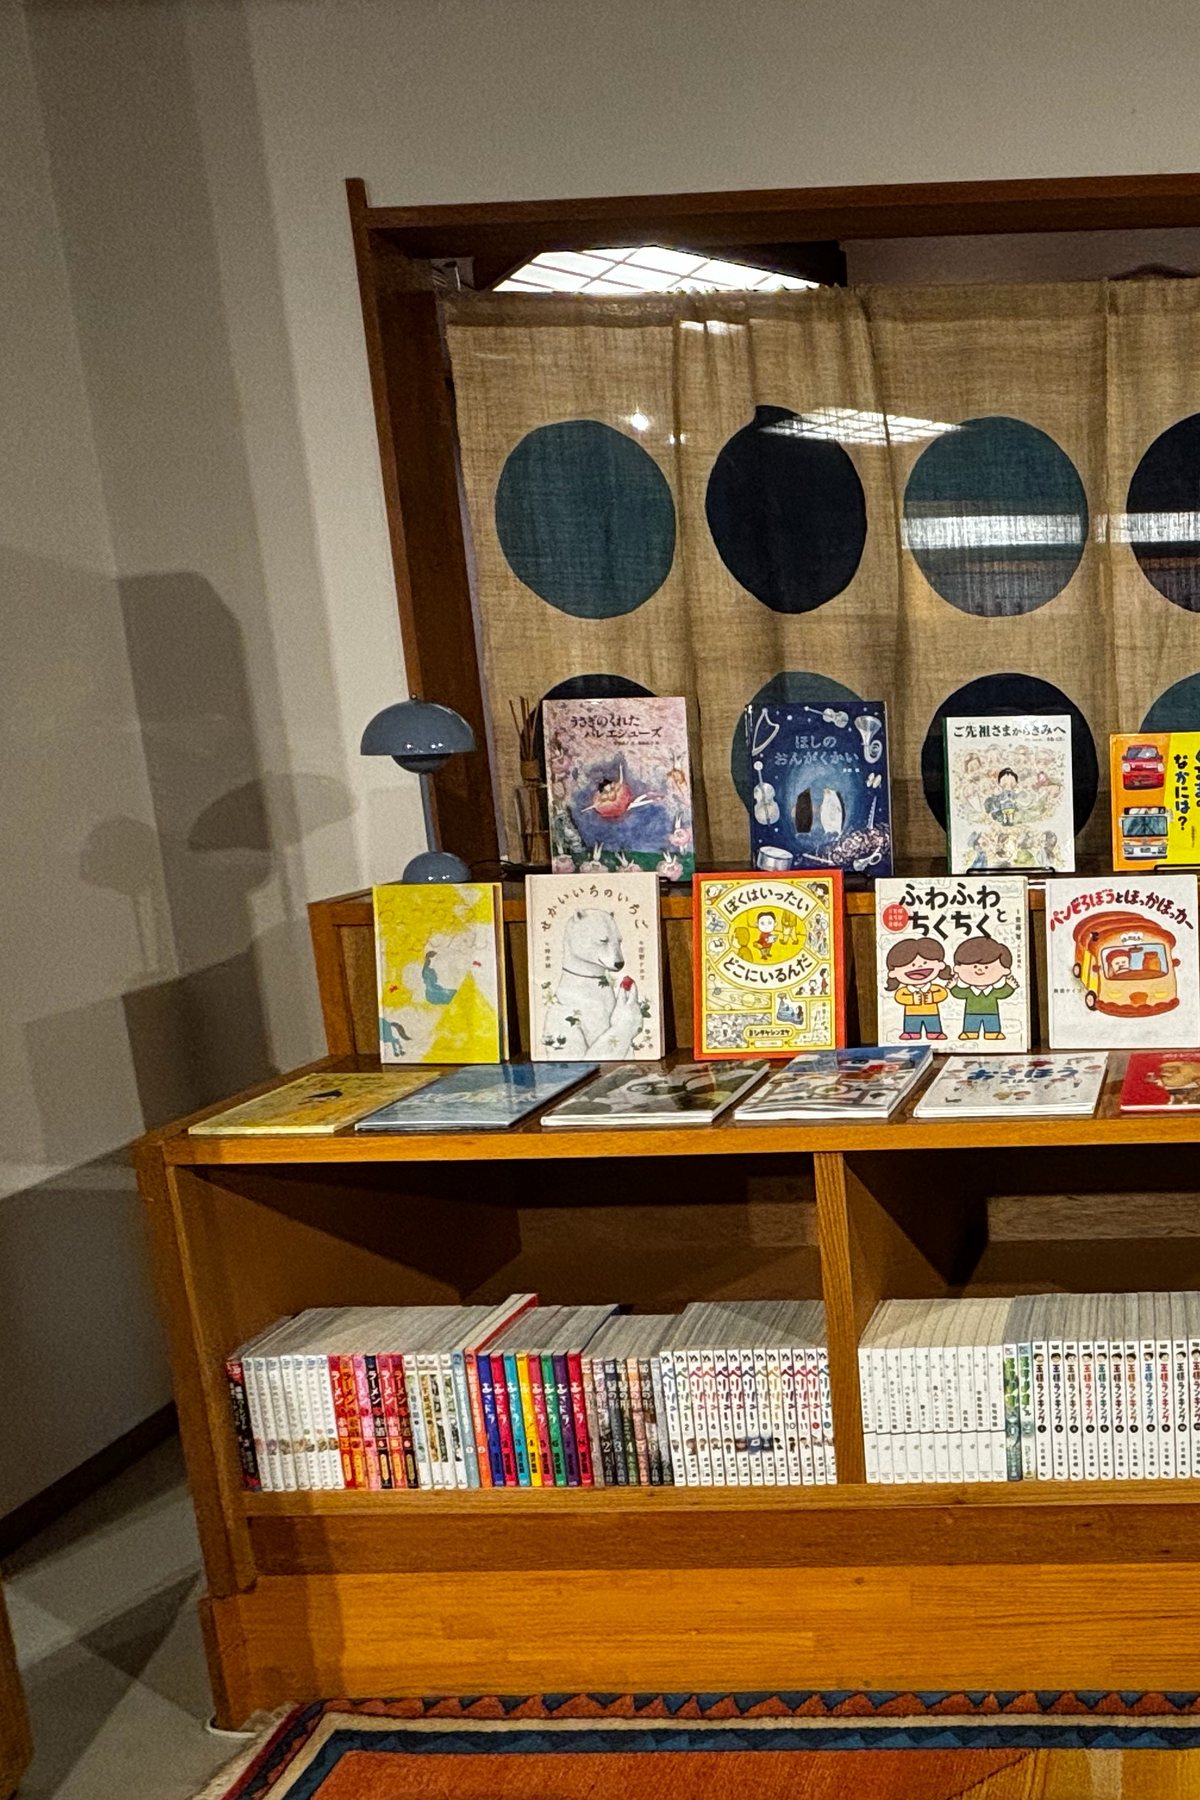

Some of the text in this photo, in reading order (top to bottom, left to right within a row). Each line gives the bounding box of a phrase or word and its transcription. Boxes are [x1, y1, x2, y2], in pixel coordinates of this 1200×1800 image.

[774, 751, 859, 766] おんがくかい
[795, 735, 837, 749] ほしの
[724, 887, 810, 915] ぼくはいったい
[899, 882, 1001, 911] ふわふわ
[996, 909, 1007, 923] と
[908, 911, 992, 941] ちくちく
[723, 953, 813, 983] どこにいるんだ
[1036, 1365, 1044, 1423] 王様ランキング
[1053, 1365, 1062, 1423] 王様ランキング
[1068, 1364, 1078, 1423] 王様ランキング
[1084, 1364, 1093, 1423] 王様ランキング
[1098, 1364, 1107, 1423] 王様ランキング
[1113, 1364, 1123, 1423] 王様ランキング
[1128, 1364, 1137, 1423] 王様ランキング
[1145, 1364, 1154, 1422] 王様ランキング
[1161, 1363, 1169, 1422] 王様ランキング
[1177, 1363, 1186, 1421] 王様ランキング
[1192, 1361, 1200, 1421] 王様ランキング
[602, 1441, 610, 1452] 2
[615, 1442, 622, 1452] 3
[627, 1442, 634, 1453] 4
